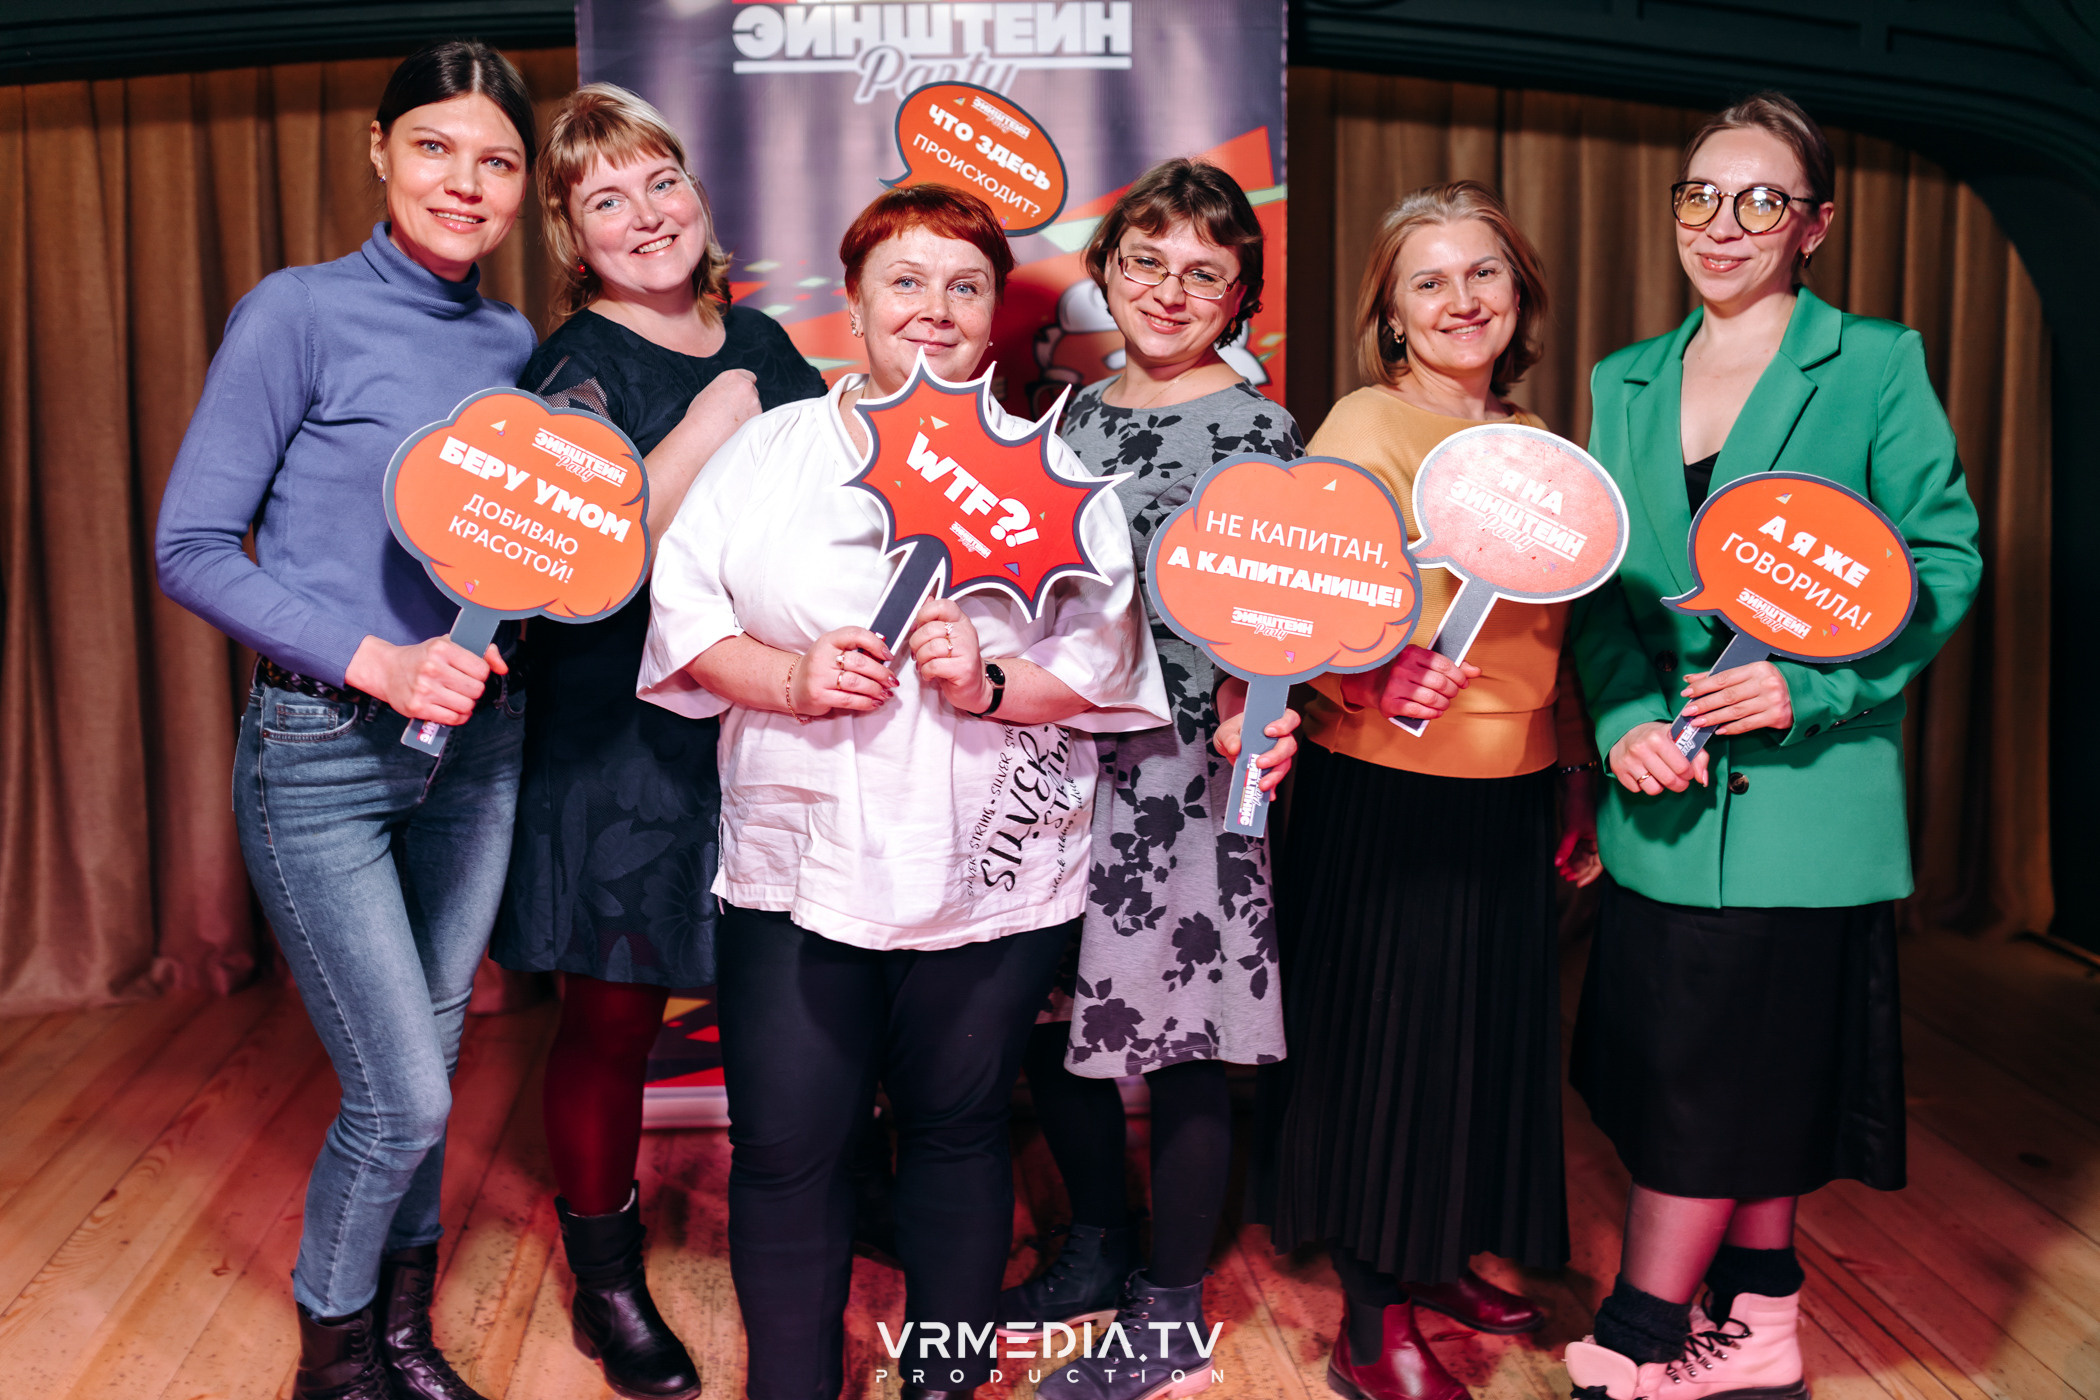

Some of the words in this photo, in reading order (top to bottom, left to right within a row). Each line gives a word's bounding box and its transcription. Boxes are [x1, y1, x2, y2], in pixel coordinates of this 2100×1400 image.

[912, 133, 1041, 218] ПРОИСХОДИТ?
[928, 103, 975, 142] ЧТО
[975, 135, 1051, 191] ЗДЕСЬ
[438, 435, 532, 492] БЕРУ
[534, 478, 631, 543] УМОМ
[555, 454, 596, 483] Party
[906, 431, 1040, 548] WTF?!
[1498, 469, 1524, 492] Я
[1519, 478, 1564, 515] НА
[448, 515, 574, 584] КРАСОТОЙ!
[462, 493, 578, 555] ДОБИВАЮ
[1205, 510, 1244, 538] НЕ
[1250, 519, 1390, 569] КАПИТАН,
[1478, 511, 1537, 553] Party
[1758, 515, 1787, 543] А
[1787, 531, 1817, 558] Я
[1812, 544, 1871, 588] ЖЕ
[1167, 546, 1191, 569] А
[1196, 550, 1403, 609] КАПИТАНИЩЕ!
[1721, 532, 1872, 632] ГОВОРИЛА!
[1254, 623, 1289, 641] Party
[1752, 604, 1788, 633] Party
[991, 752, 1013, 796] SILVER
[980, 730, 1051, 892] SILVER
